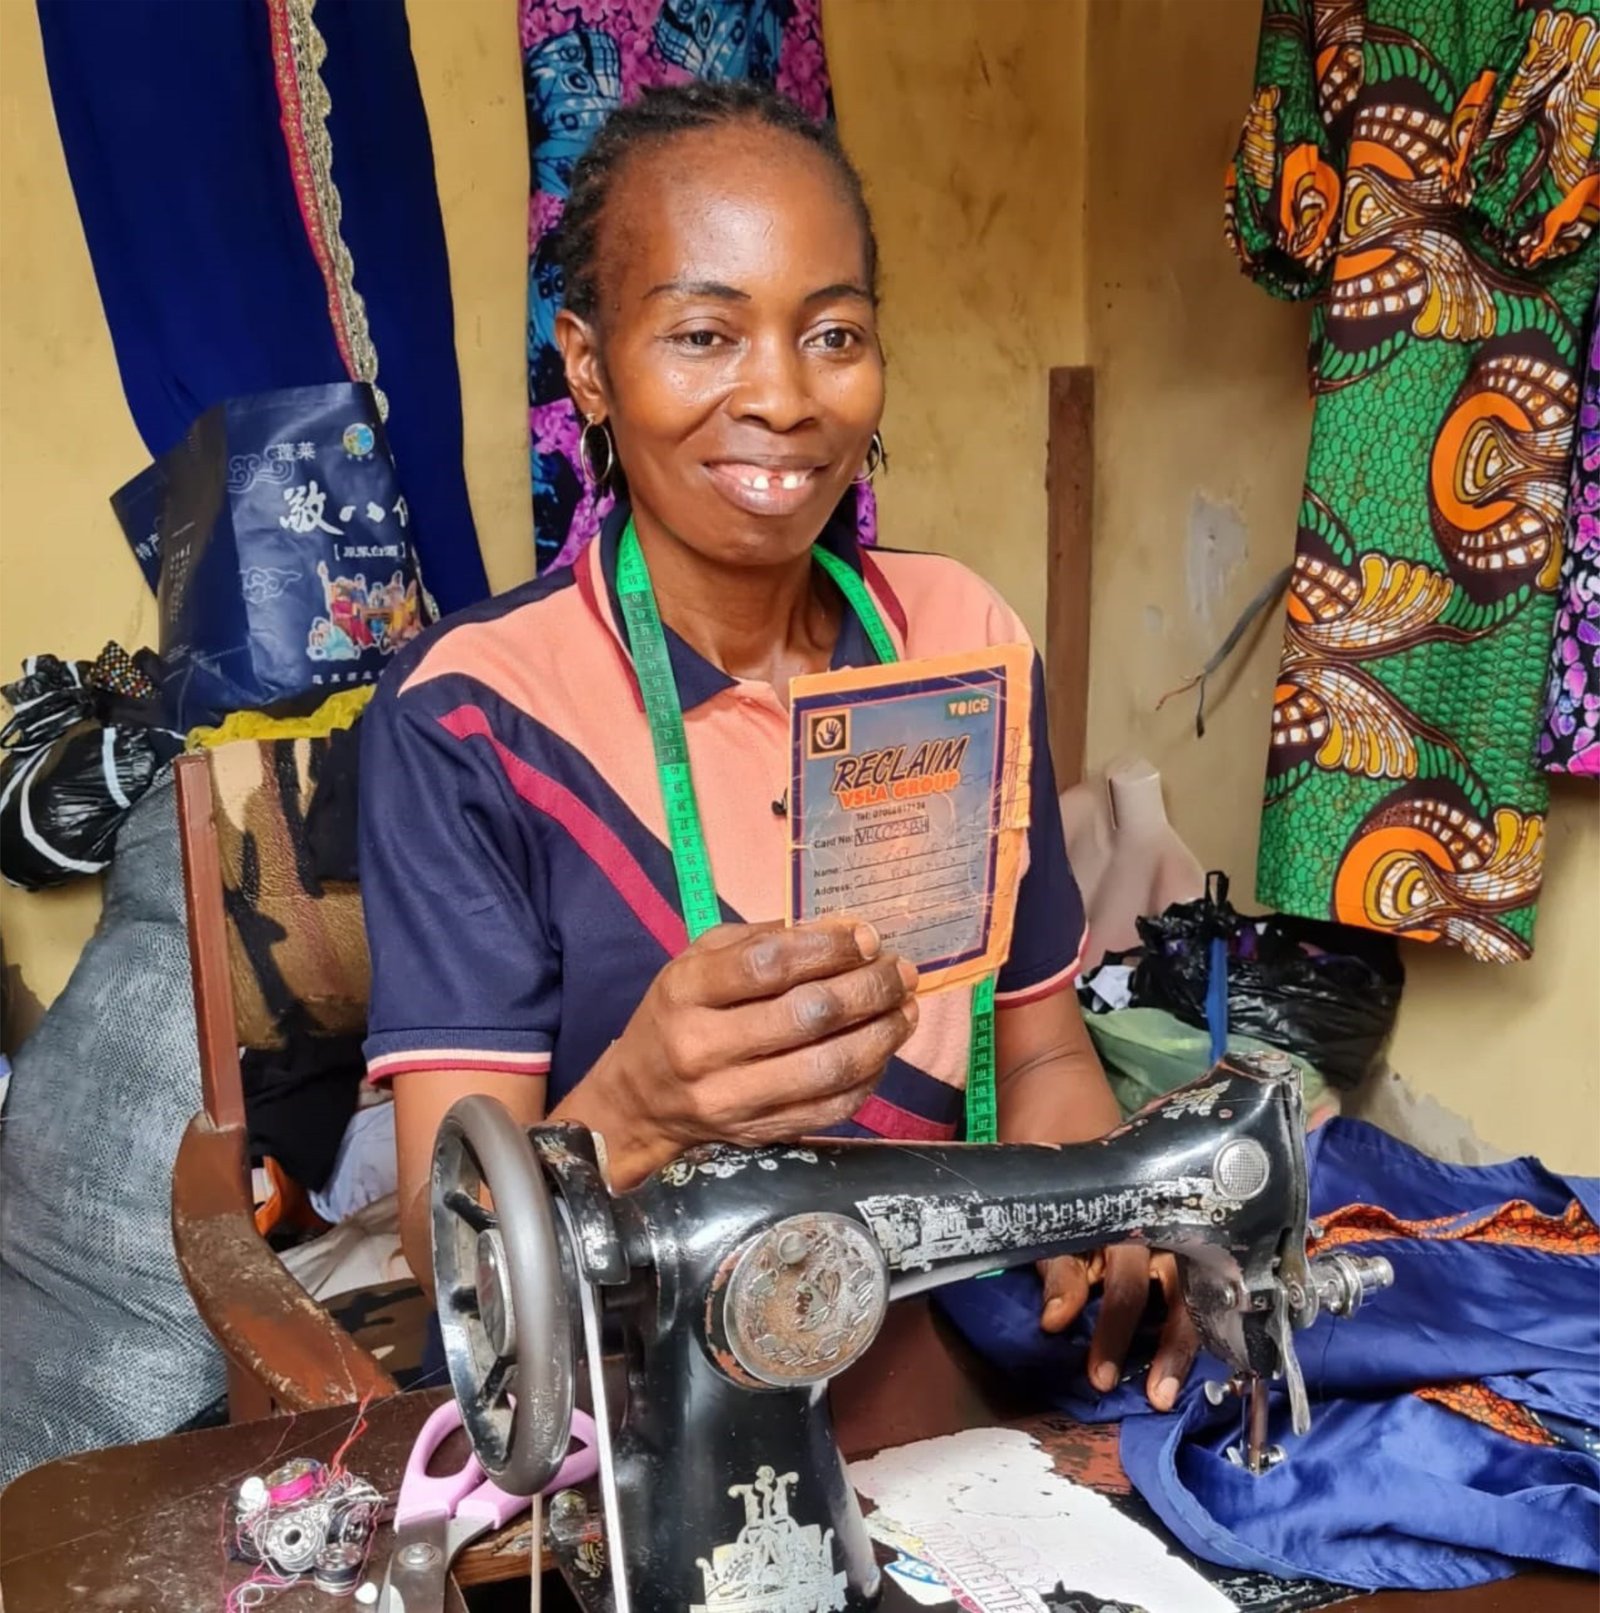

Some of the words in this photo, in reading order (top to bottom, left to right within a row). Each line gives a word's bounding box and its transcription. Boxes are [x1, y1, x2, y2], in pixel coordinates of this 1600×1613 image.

[833, 735, 970, 791] RECLAIM
[838, 784, 888, 810] VSLA
[893, 772, 960, 800] GROUP
